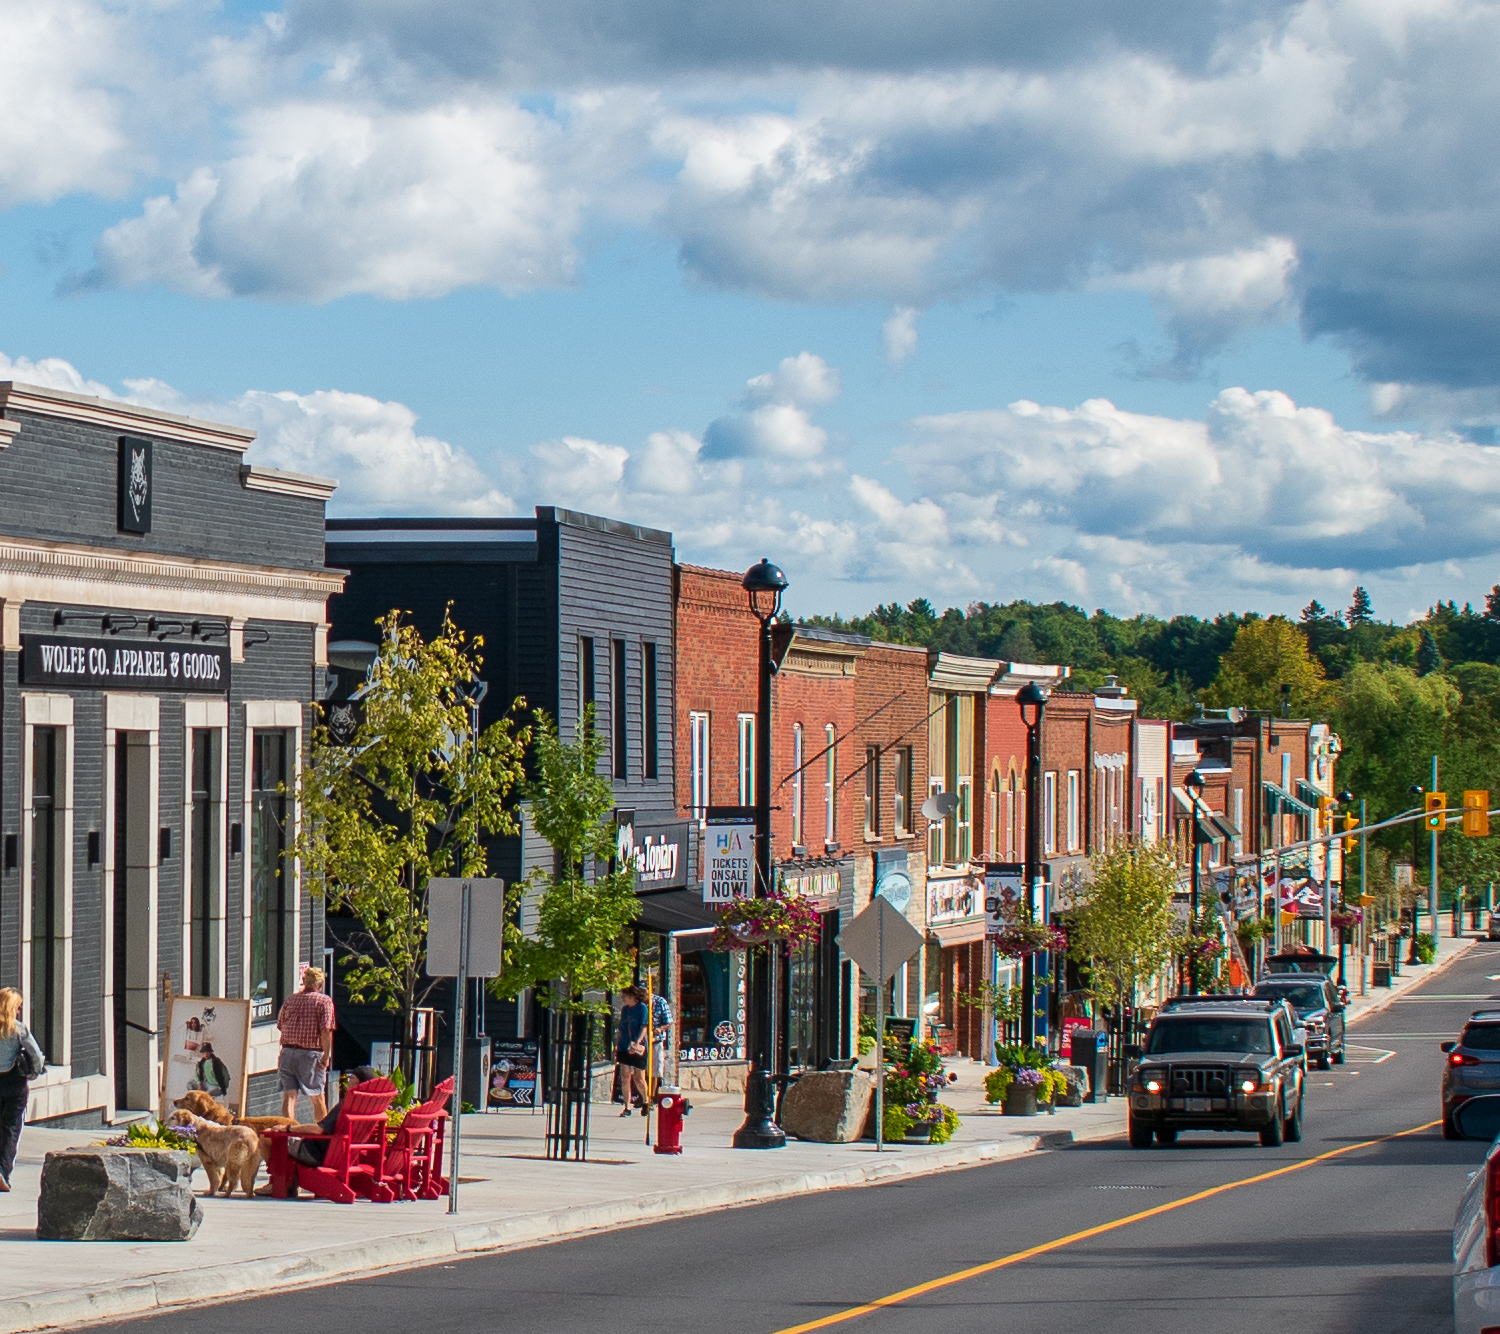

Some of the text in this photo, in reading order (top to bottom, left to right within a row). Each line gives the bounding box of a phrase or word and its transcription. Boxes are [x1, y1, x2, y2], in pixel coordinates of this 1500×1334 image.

[40, 644, 221, 681] WOLFE CO. APPAREL & GOODS
[645, 834, 679, 880] Topiary
[712, 857, 748, 868] TICKETS
[711, 881, 748, 898] NOW!
